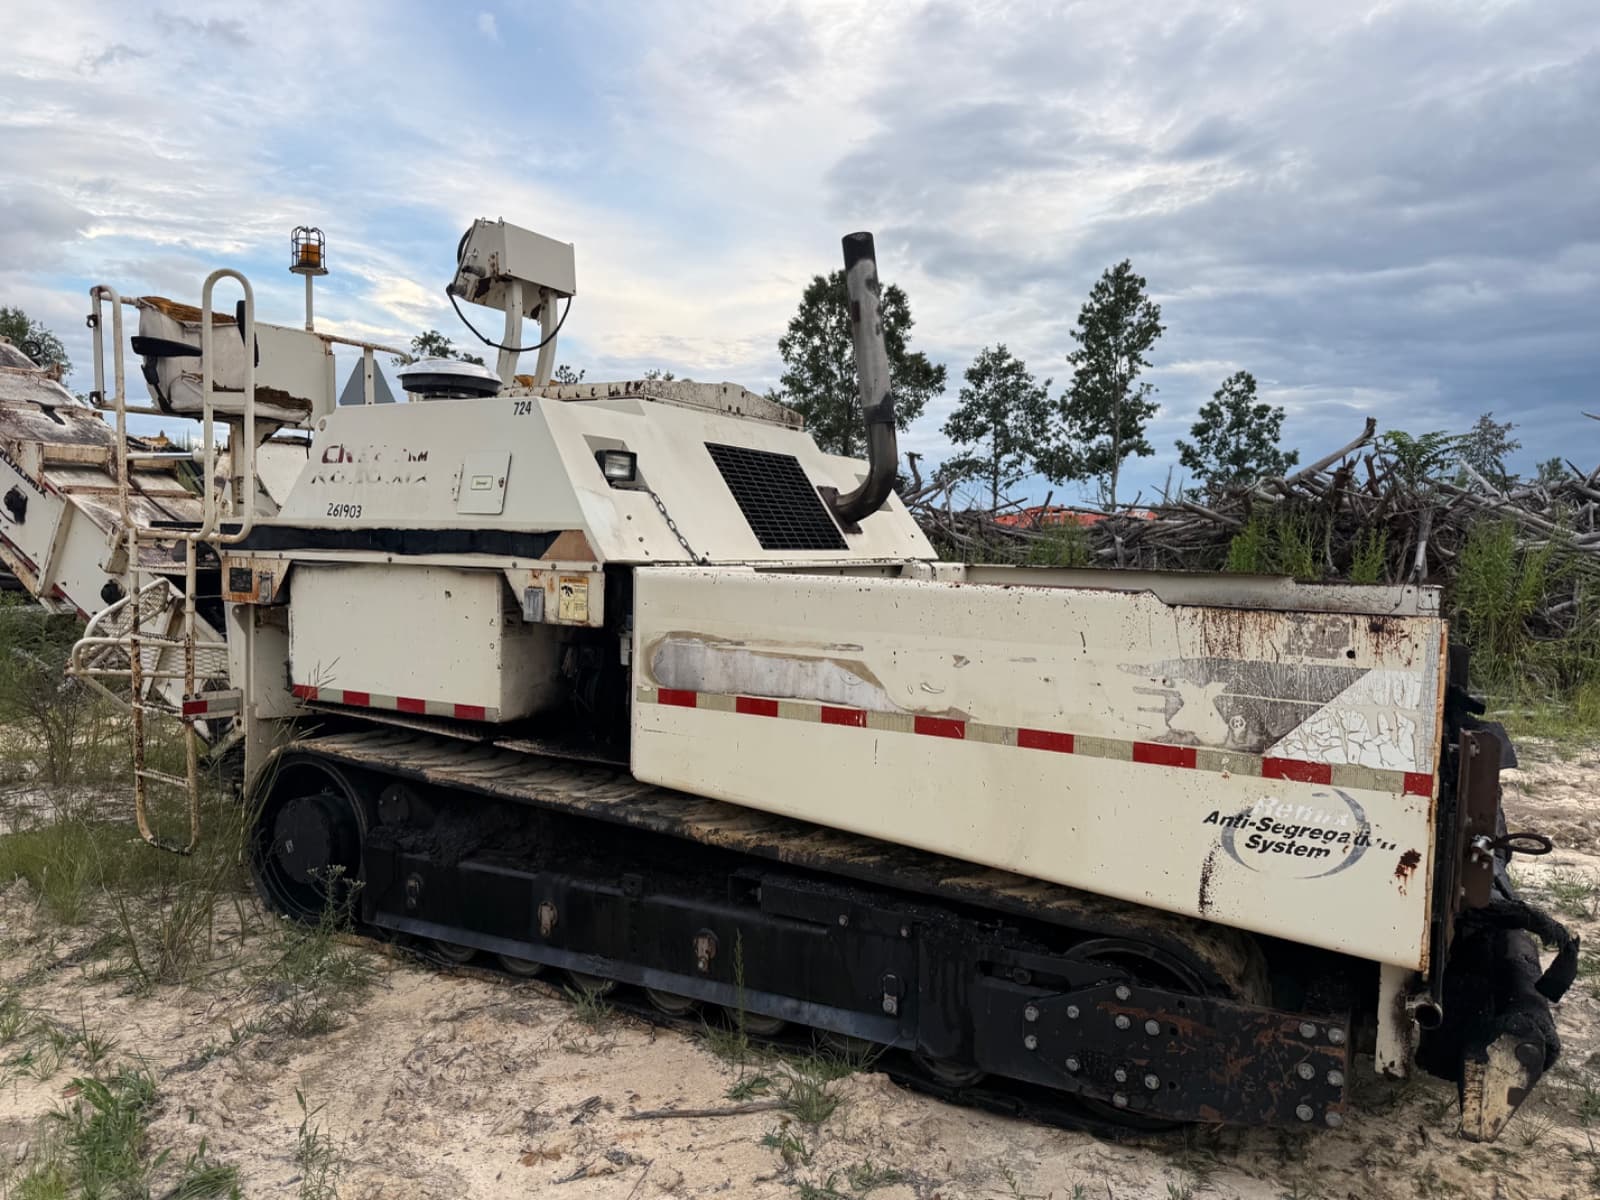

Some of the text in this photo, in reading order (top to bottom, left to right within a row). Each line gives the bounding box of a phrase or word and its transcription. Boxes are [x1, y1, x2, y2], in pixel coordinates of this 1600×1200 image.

[513, 400, 532, 416] 724
[327, 502, 362, 518] 261903
[1244, 833, 1331, 859] System
